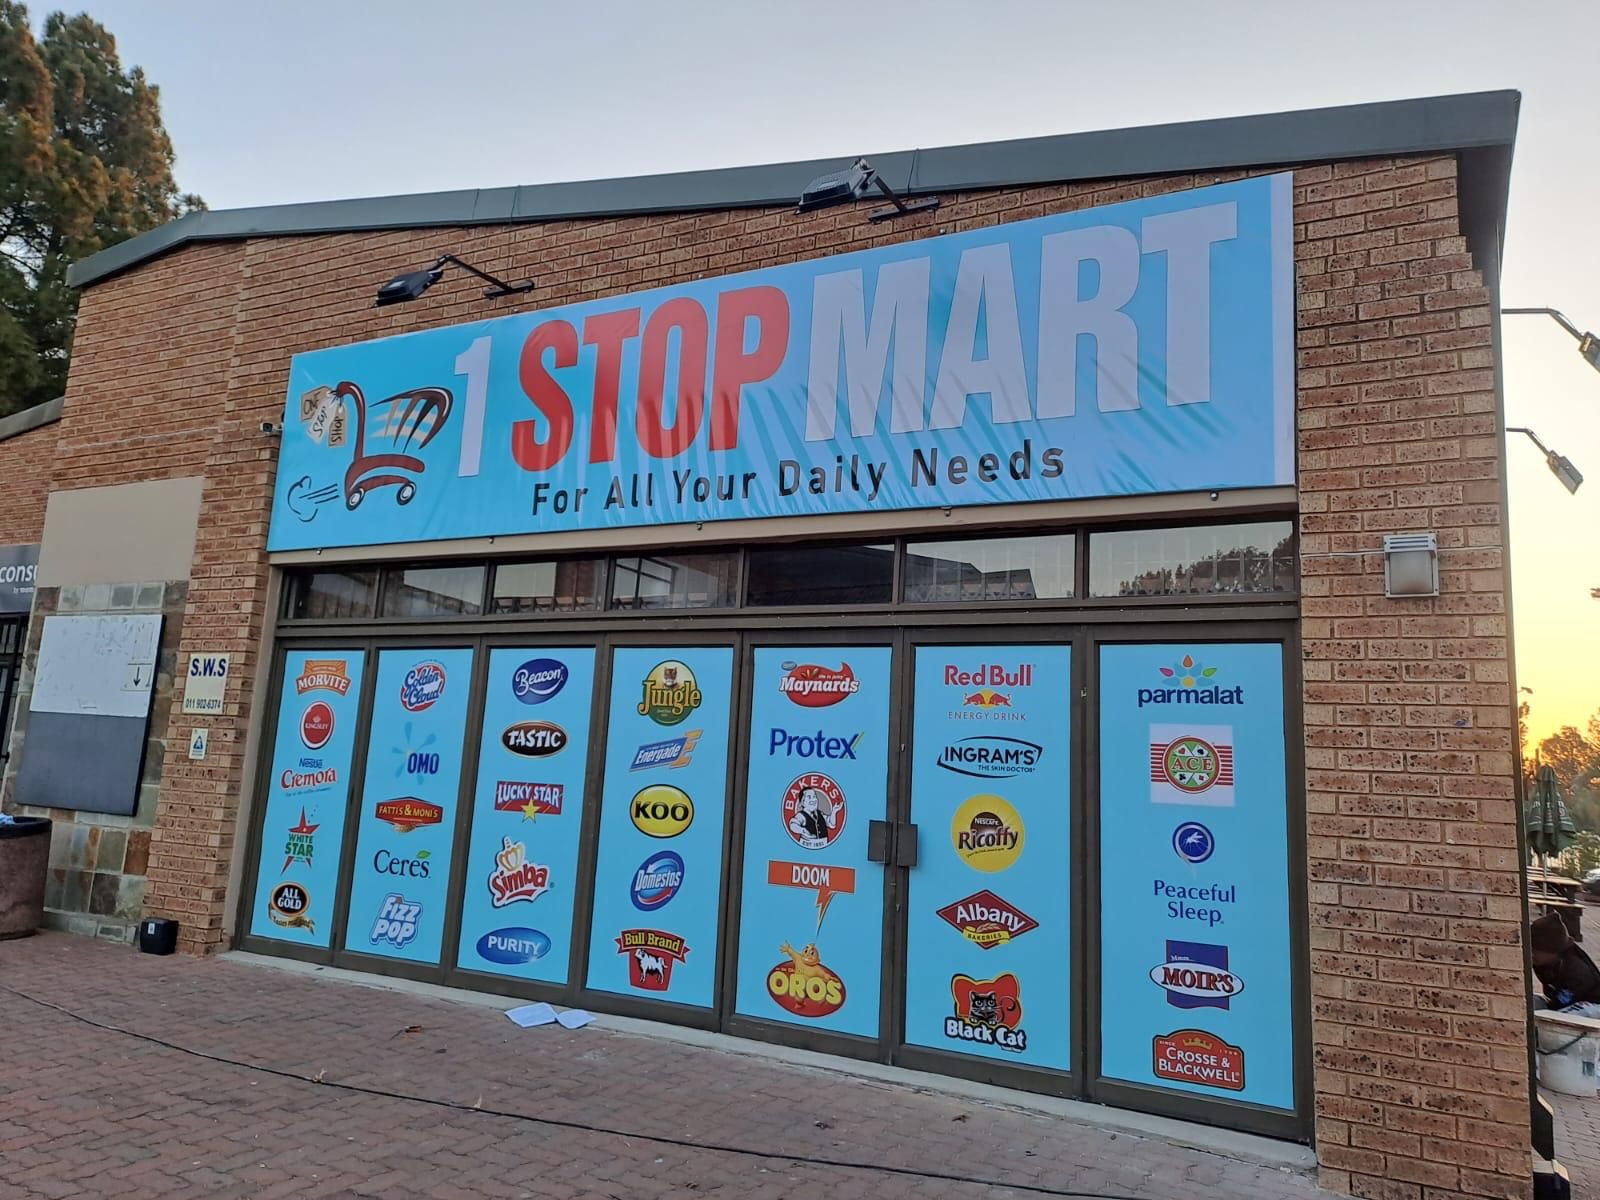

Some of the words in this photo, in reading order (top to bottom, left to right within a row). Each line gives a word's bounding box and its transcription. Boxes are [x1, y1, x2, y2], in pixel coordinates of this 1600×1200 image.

[454, 336, 492, 477] 1
[510, 285, 792, 472] STOP
[804, 201, 1239, 442] MART
[532, 482, 589, 515] For
[603, 472, 653, 510] All
[672, 469, 757, 504] Your
[778, 454, 888, 502] Daily
[911, 439, 1064, 487] Needs
[190, 657, 227, 677] S.W.S
[944, 664, 985, 686] Red
[989, 664, 1032, 686] Bull
[297, 673, 349, 691] MORVITE
[408, 680, 443, 707] Cloud
[515, 668, 562, 696] Beacon
[779, 677, 860, 696] Maynards
[637, 679, 702, 716] Jungle
[1137, 685, 1244, 708] parmalat
[947, 711, 990, 720] ENERGY
[993, 711, 1026, 721] DRINK
[507, 729, 562, 748] TASTIC
[769, 728, 861, 760] Protex
[407, 752, 440, 775] OMO
[634, 743, 682, 765] Energade
[944, 746, 1035, 765] INGRAM'S
[1171, 756, 1213, 771] ACE
[281, 767, 337, 789] Cremora
[497, 782, 532, 804] LUCKY
[533, 784, 560, 808] STAR
[785, 775, 840, 811] BAKERS
[404, 804, 412, 816] &
[634, 800, 690, 821] KOO
[284, 842, 314, 858] STAR
[288, 833, 313, 844] WHITE
[958, 826, 1019, 851] Ricoffy
[373, 849, 430, 879] Ceres
[490, 863, 549, 902] Simba
[634, 869, 682, 892] Domestos
[791, 865, 830, 887] DOOM
[281, 887, 301, 899] ALL
[1153, 879, 1236, 903] Peaceful
[277, 897, 302, 910] GOLD
[1167, 901, 1222, 927] Sleep
[956, 903, 1026, 932] Albany
[371, 918, 415, 943] POP
[967, 933, 1002, 941] BAKERIES
[487, 935, 542, 955] PURITY
[624, 932, 645, 946] Bull
[647, 935, 681, 953] Brand
[769, 970, 843, 1006] OROS
[1160, 966, 1234, 994] MOIR'S
[946, 1019, 992, 1043] Black
[995, 1027, 1025, 1048] Cat
[1166, 1047, 1218, 1066] CROSSE
[1221, 1057, 1231, 1068] &
[1158, 1058, 1239, 1083] BLACKWELL
